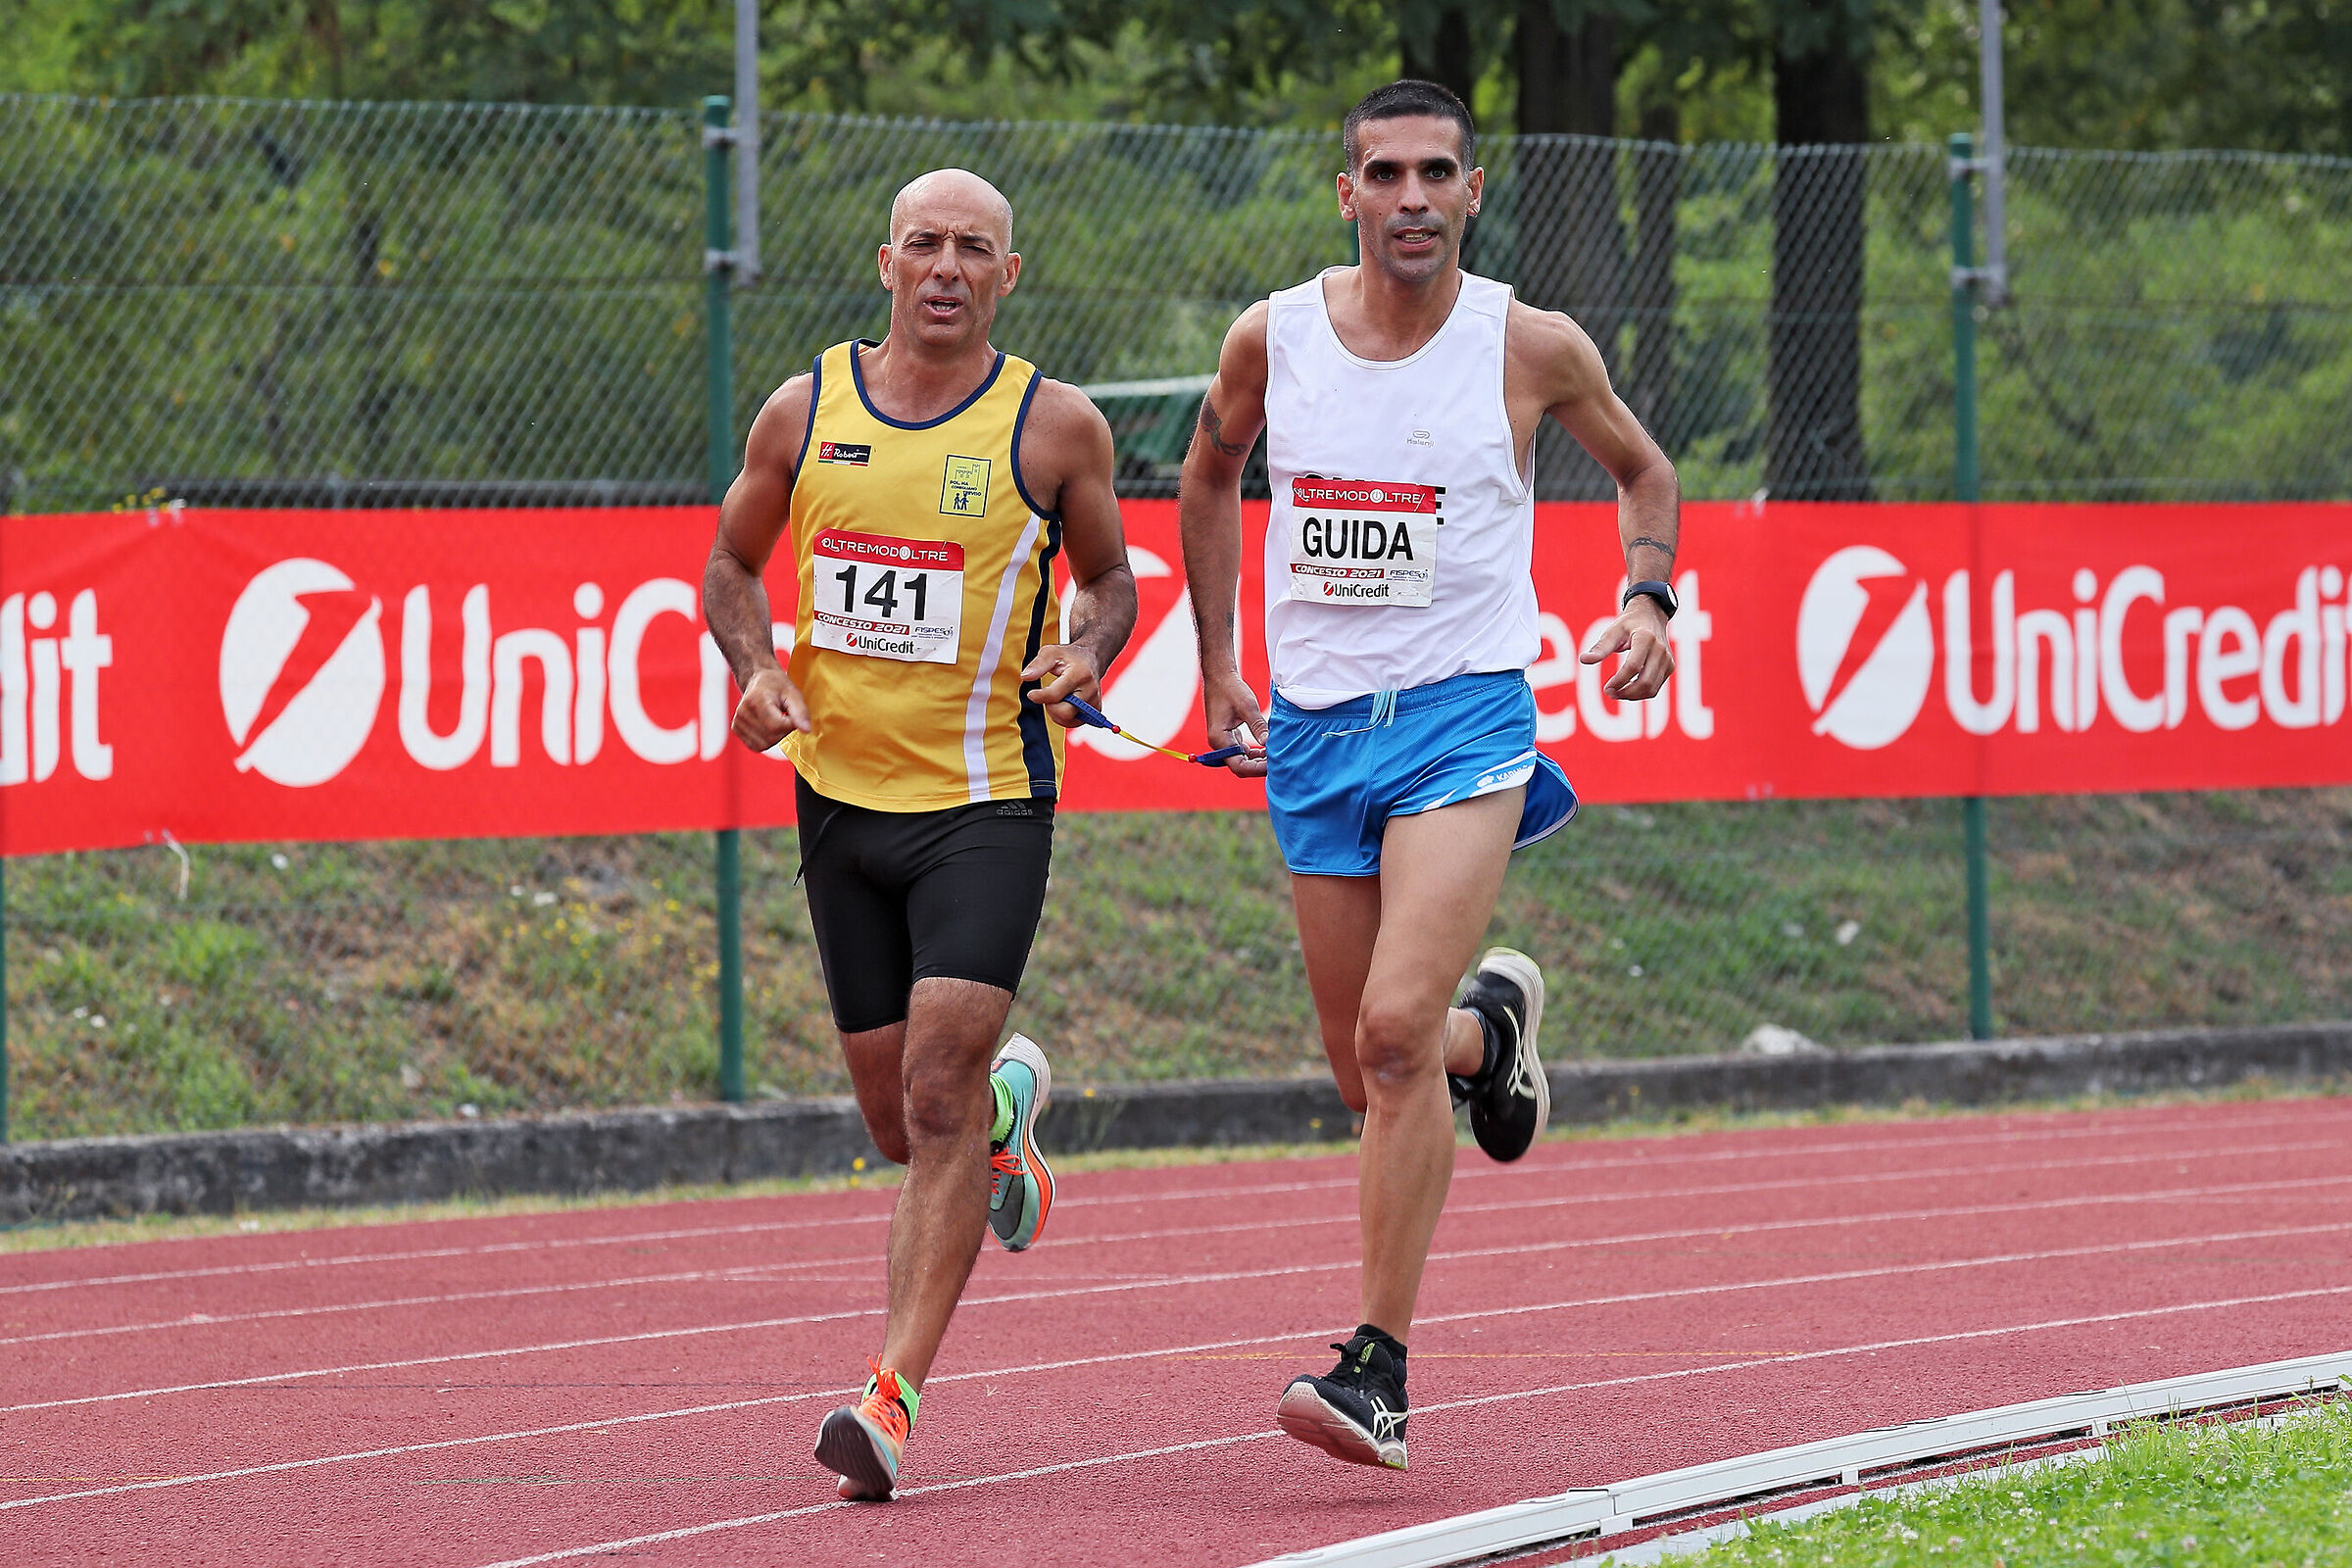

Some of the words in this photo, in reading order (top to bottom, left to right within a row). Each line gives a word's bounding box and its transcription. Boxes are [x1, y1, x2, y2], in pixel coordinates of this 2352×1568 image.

[1302, 516, 1414, 561] GUIDA
[1295, 564, 1347, 577] CONCESIO
[1348, 568, 1382, 578] 2021
[835, 564, 928, 621] 141
[1334, 583, 1390, 598] UniCredit
[817, 612, 873, 630] CONCESIO
[874, 623, 908, 635] 2021
[858, 635, 914, 655] UniCredit
[1941, 564, 2352, 736] UniCredi
